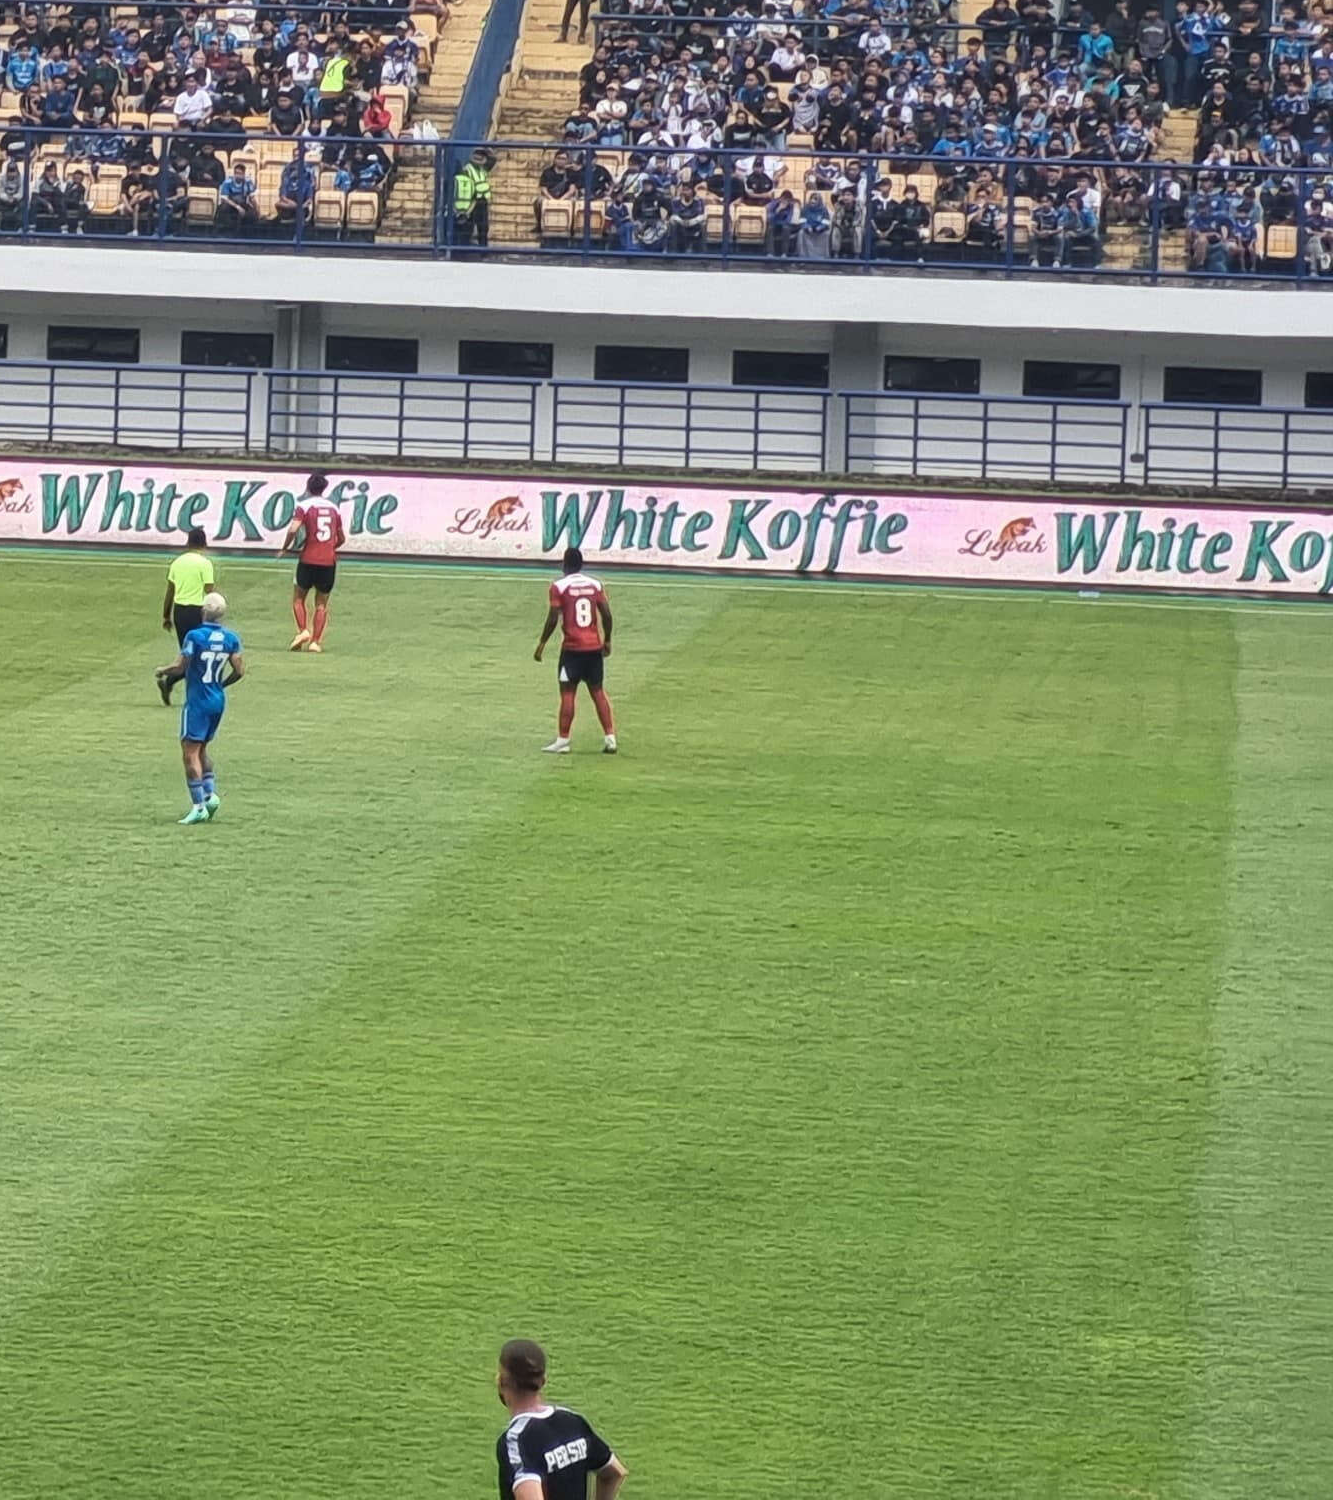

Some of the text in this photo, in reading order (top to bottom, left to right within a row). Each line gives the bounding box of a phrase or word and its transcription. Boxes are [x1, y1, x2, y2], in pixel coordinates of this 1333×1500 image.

[39, 468, 209, 535] White
[315, 515, 333, 543] 5
[540, 489, 714, 553] White
[718, 492, 909, 573] Koffie
[1054, 510, 1233, 575] White
[574, 597, 593, 628] 8
